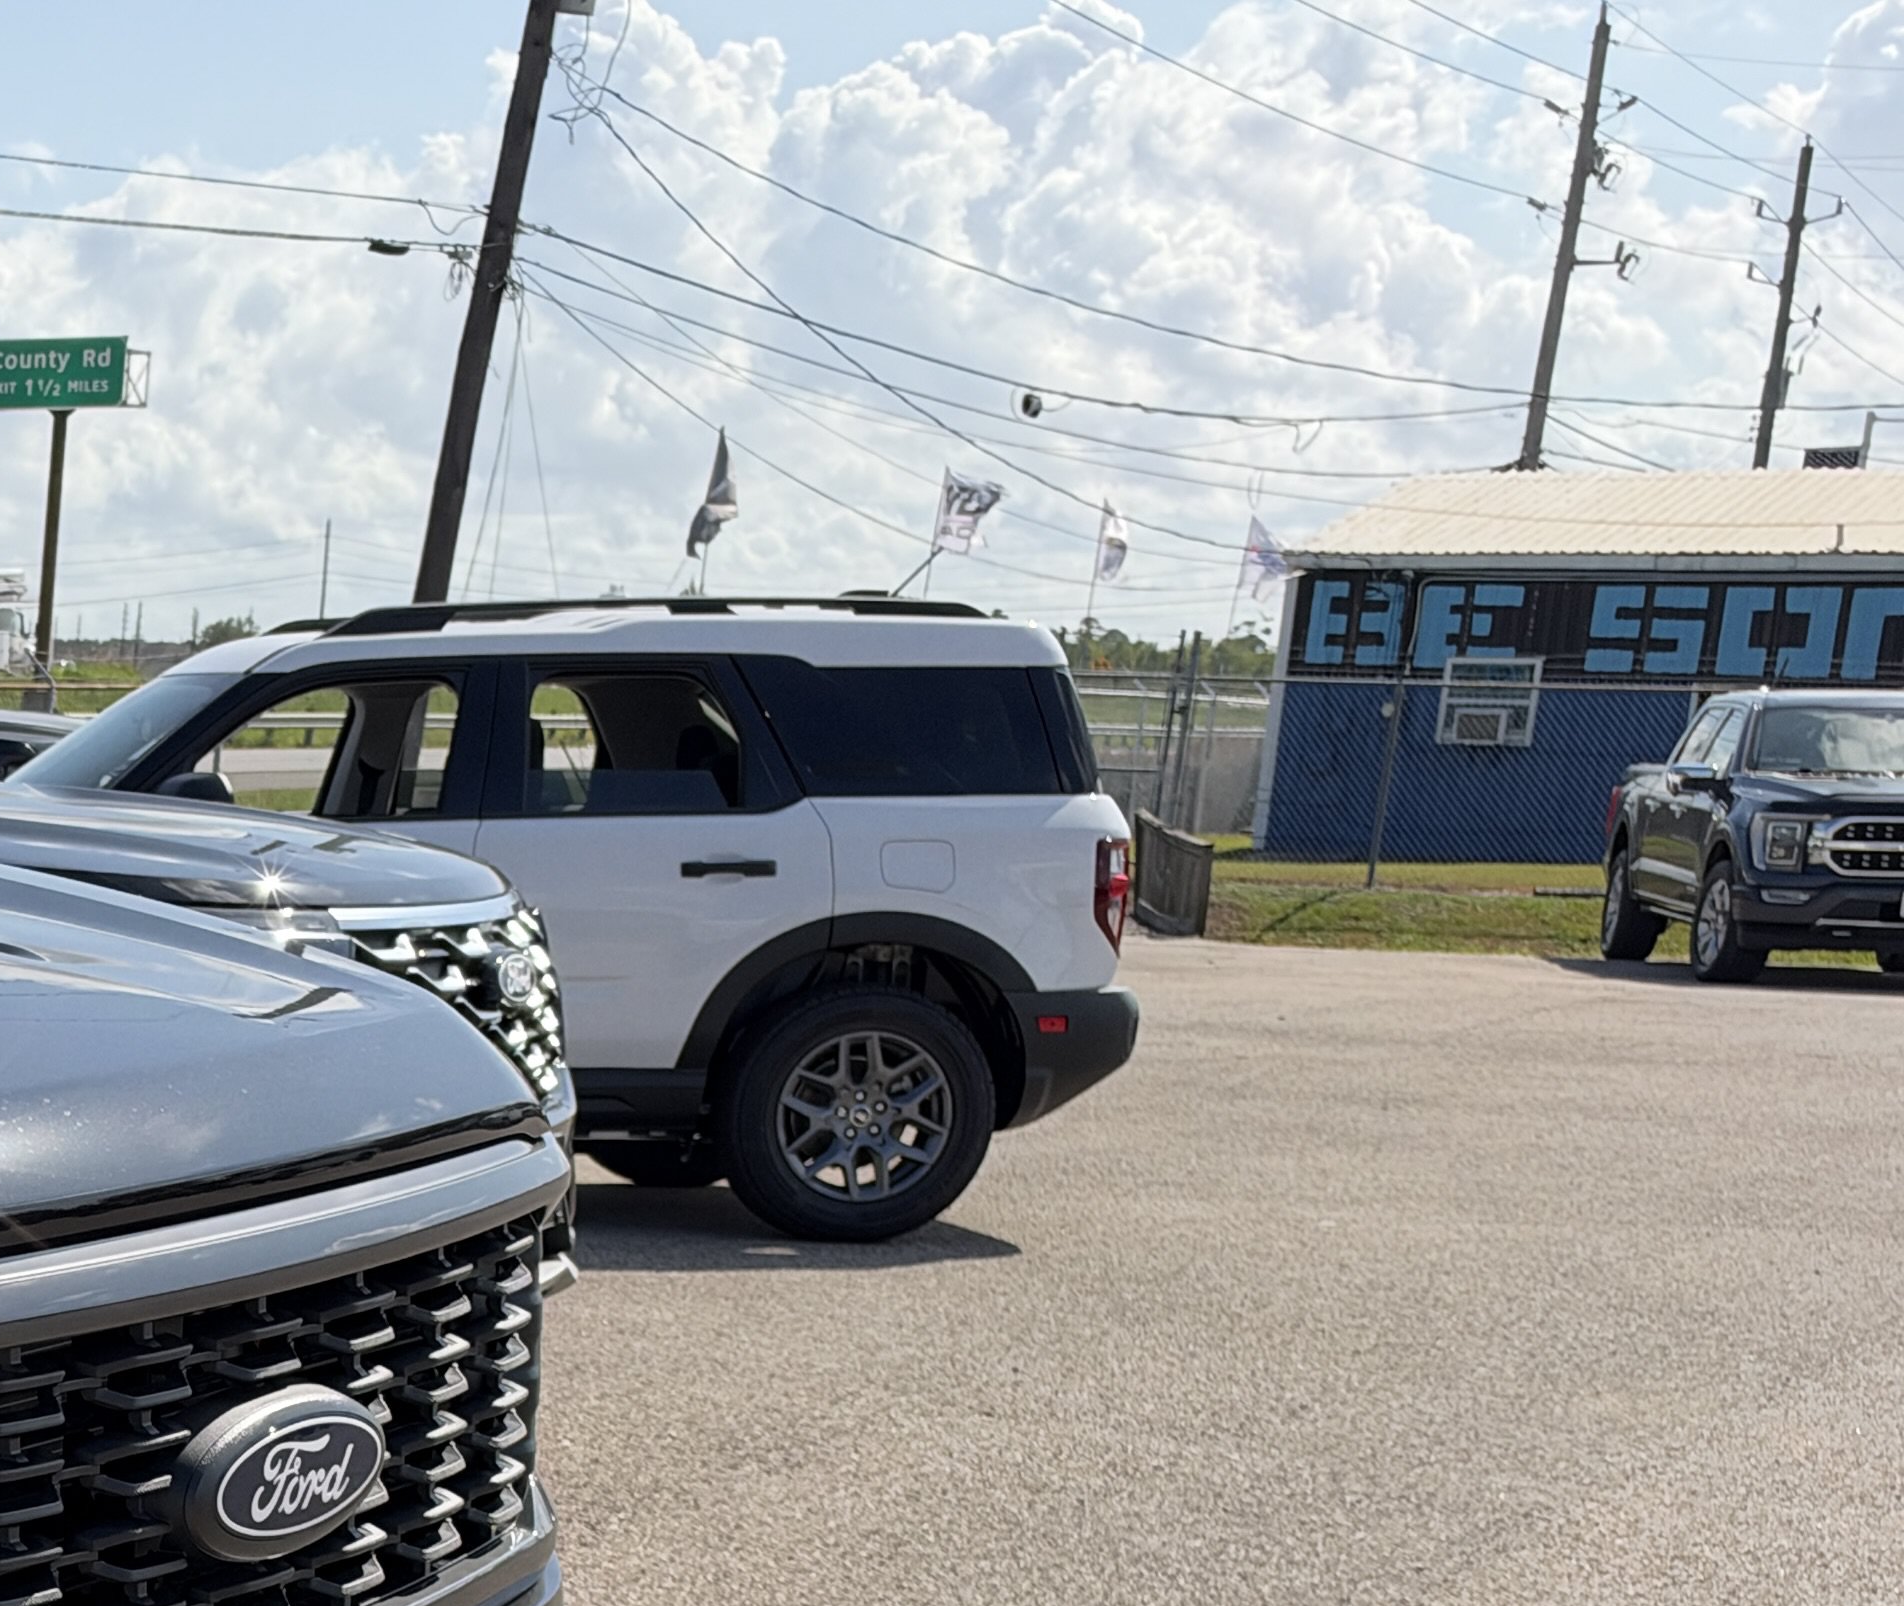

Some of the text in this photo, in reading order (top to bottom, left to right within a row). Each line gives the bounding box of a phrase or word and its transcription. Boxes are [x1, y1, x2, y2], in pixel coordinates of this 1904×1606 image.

[82, 347, 112, 368] Rd
[67, 379, 109, 393] MILES
[1304, 580, 1525, 669] BE
[250, 1433, 355, 1523] Ford
